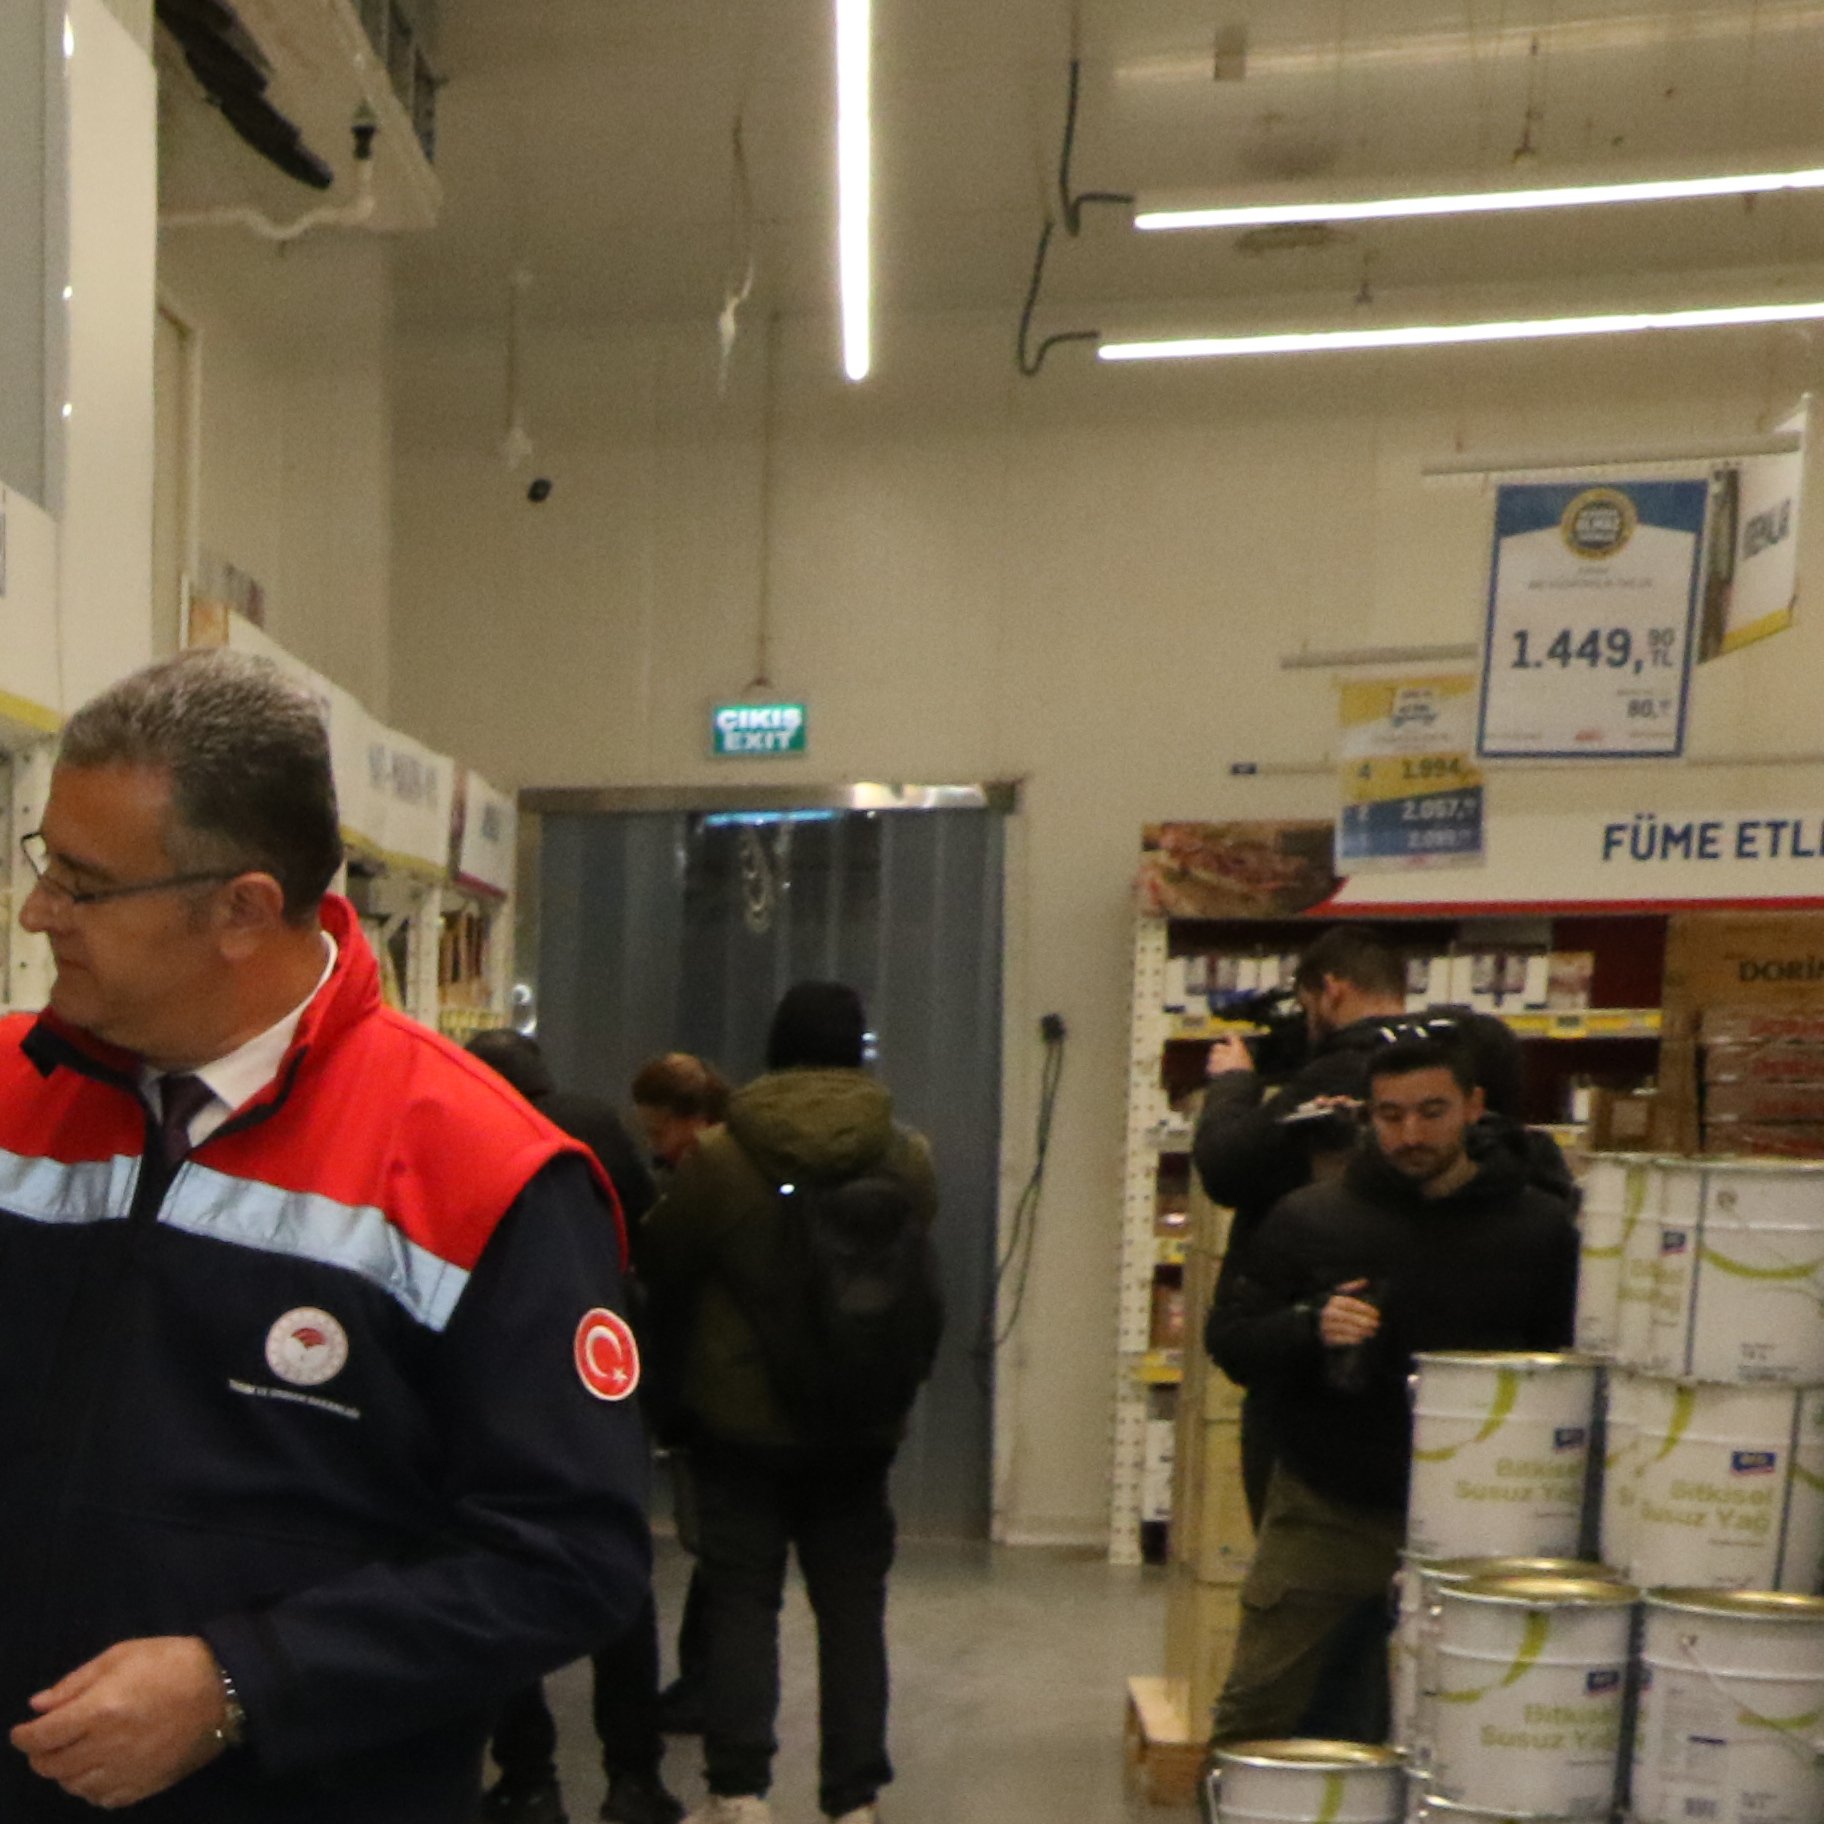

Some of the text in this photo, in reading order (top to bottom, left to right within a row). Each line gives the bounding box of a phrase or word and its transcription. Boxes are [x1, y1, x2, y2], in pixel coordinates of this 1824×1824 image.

[1510, 628, 1644, 675] 1.449,
[1651, 648, 1673, 668] TL
[723, 731, 793, 751] EXIT
[1602, 812, 1722, 862] FÜME
